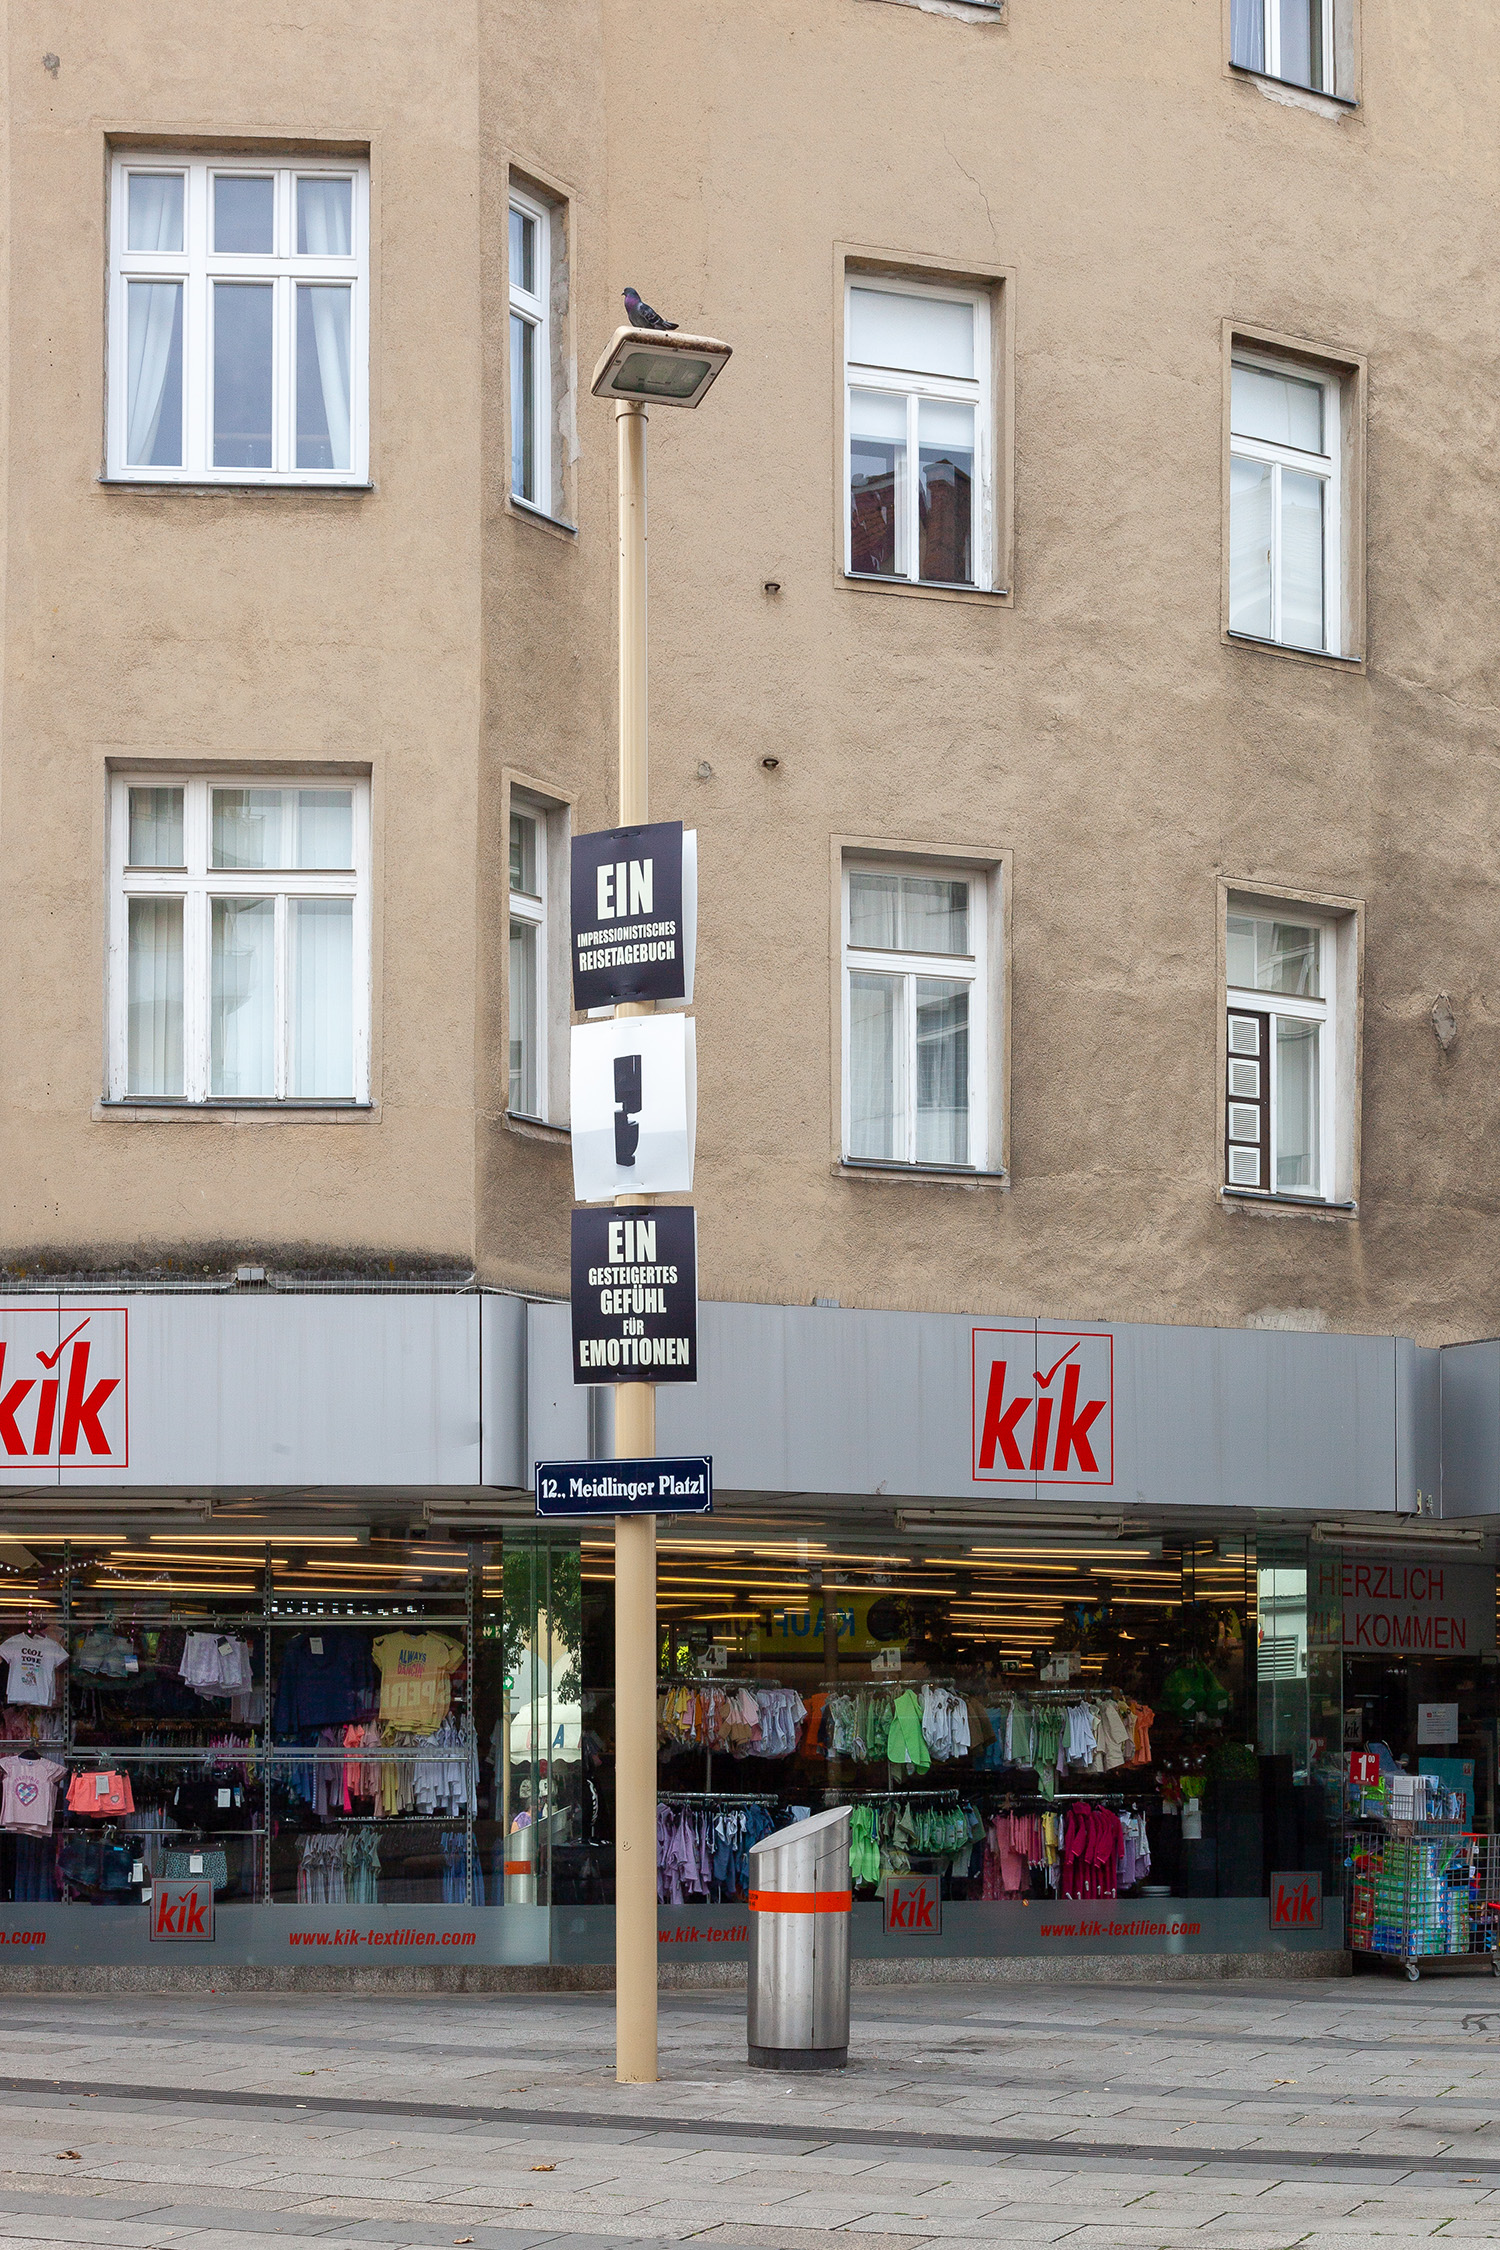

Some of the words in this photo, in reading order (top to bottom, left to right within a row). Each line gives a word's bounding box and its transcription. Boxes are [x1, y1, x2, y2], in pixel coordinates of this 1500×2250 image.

[597, 858, 653, 920] EIN
[577, 921, 676, 947] IMPRESSIONISTISCHES
[579, 940, 675, 971] REISETAGEBUCH
[608, 1220, 657, 1263] EIN
[588, 1265, 678, 1286] GESTEIGERTES
[600, 1284, 667, 1315] GEFÜHL
[623, 1317, 644, 1336] FÜR
[579, 1337, 689, 1367] EMOTIONEN
[978, 1342, 1107, 1473] kik
[541, 1479, 566, 1499] 12.,
[569, 1477, 655, 1501] Meidlinger
[659, 1474, 705, 1496] Platzl
[1318, 1563, 1444, 1601] HERZLICH
[21, 1647, 43, 1657] COOL
[399, 1649, 427, 1664] ALWAYS
[157, 1883, 208, 1934] kik
[889, 1880, 935, 1928] kik
[1275, 1876, 1318, 1922] kik
[288, 1929, 477, 1946] www.kik-textilien.com
[657, 1926, 749, 1943] w.kik-textil
[1040, 1920, 1201, 1937] www.kik-textilien.com
